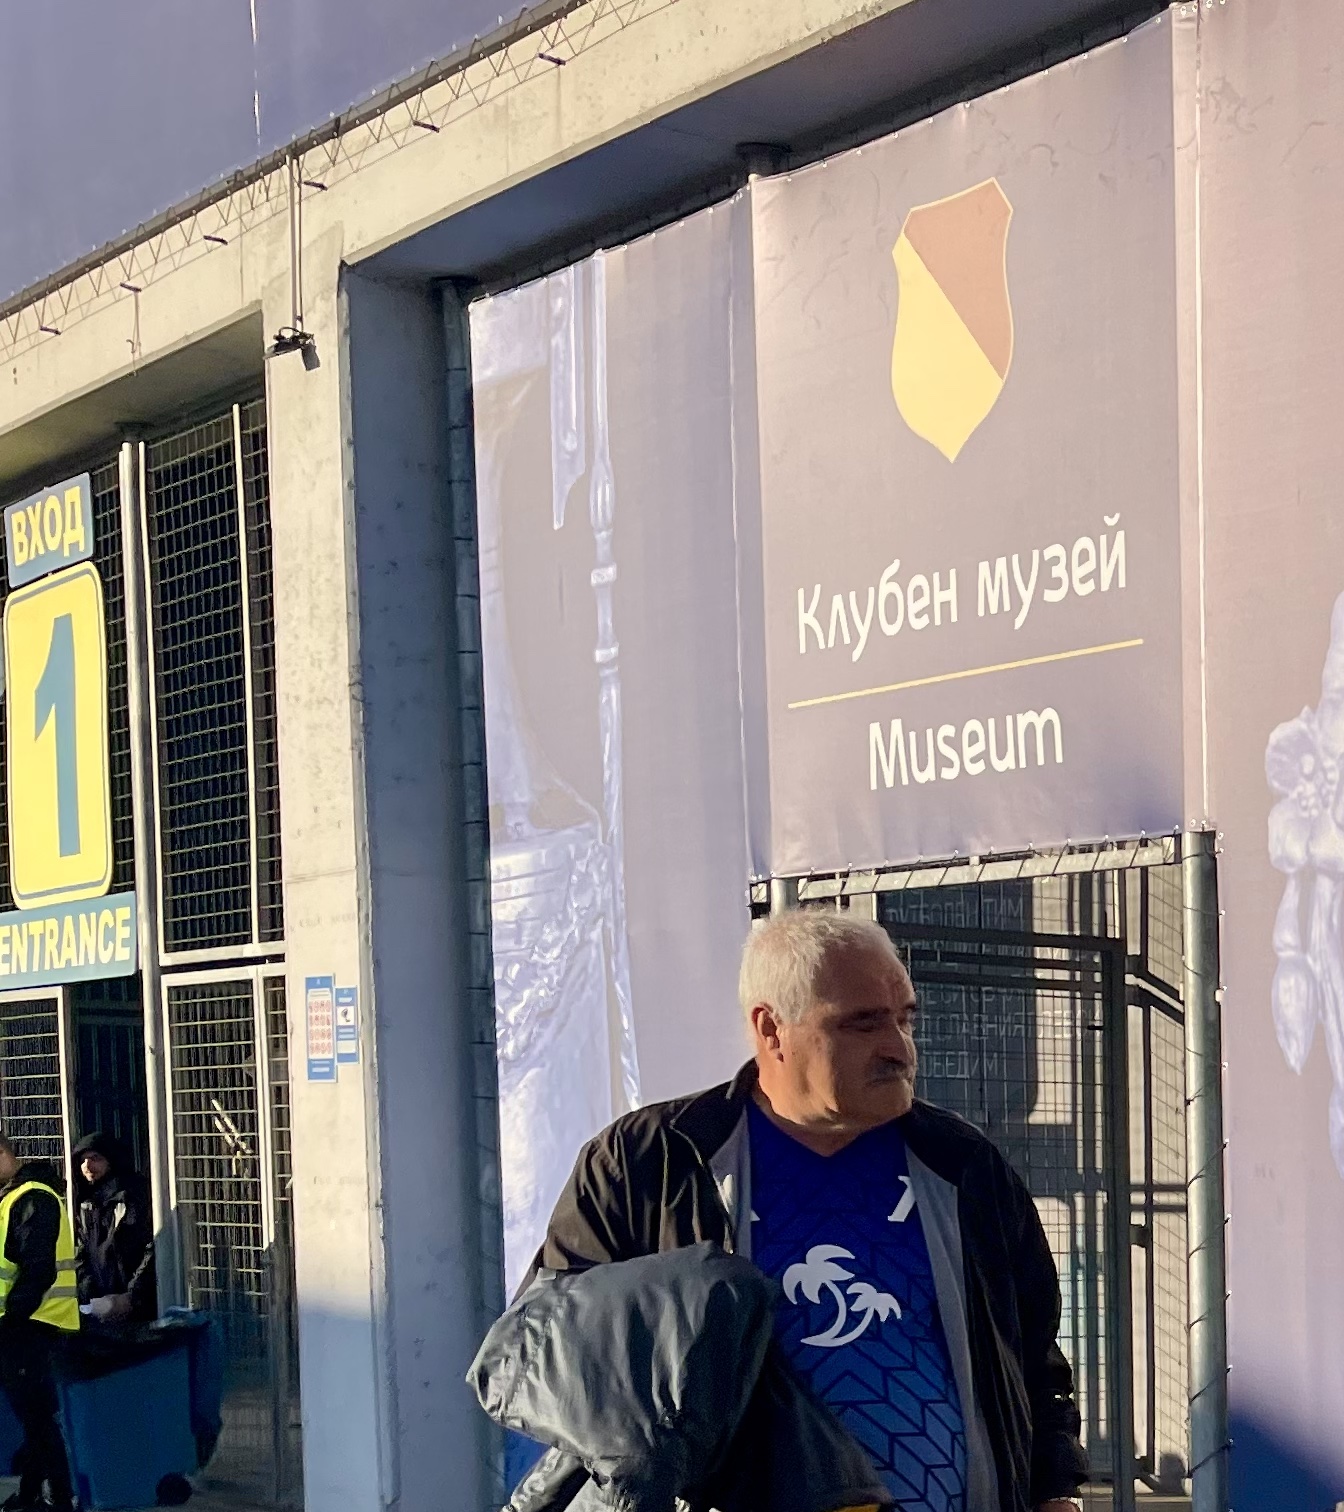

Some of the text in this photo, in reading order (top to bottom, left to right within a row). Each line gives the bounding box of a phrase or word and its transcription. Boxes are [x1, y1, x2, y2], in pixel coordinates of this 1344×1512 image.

[11, 484, 86, 568] ВХОД
[797, 512, 1127, 662] Клубен музей
[34, 612, 82, 857] 1
[868, 706, 1064, 791] Museum
[0, 906, 132, 976] ENTRANCE
